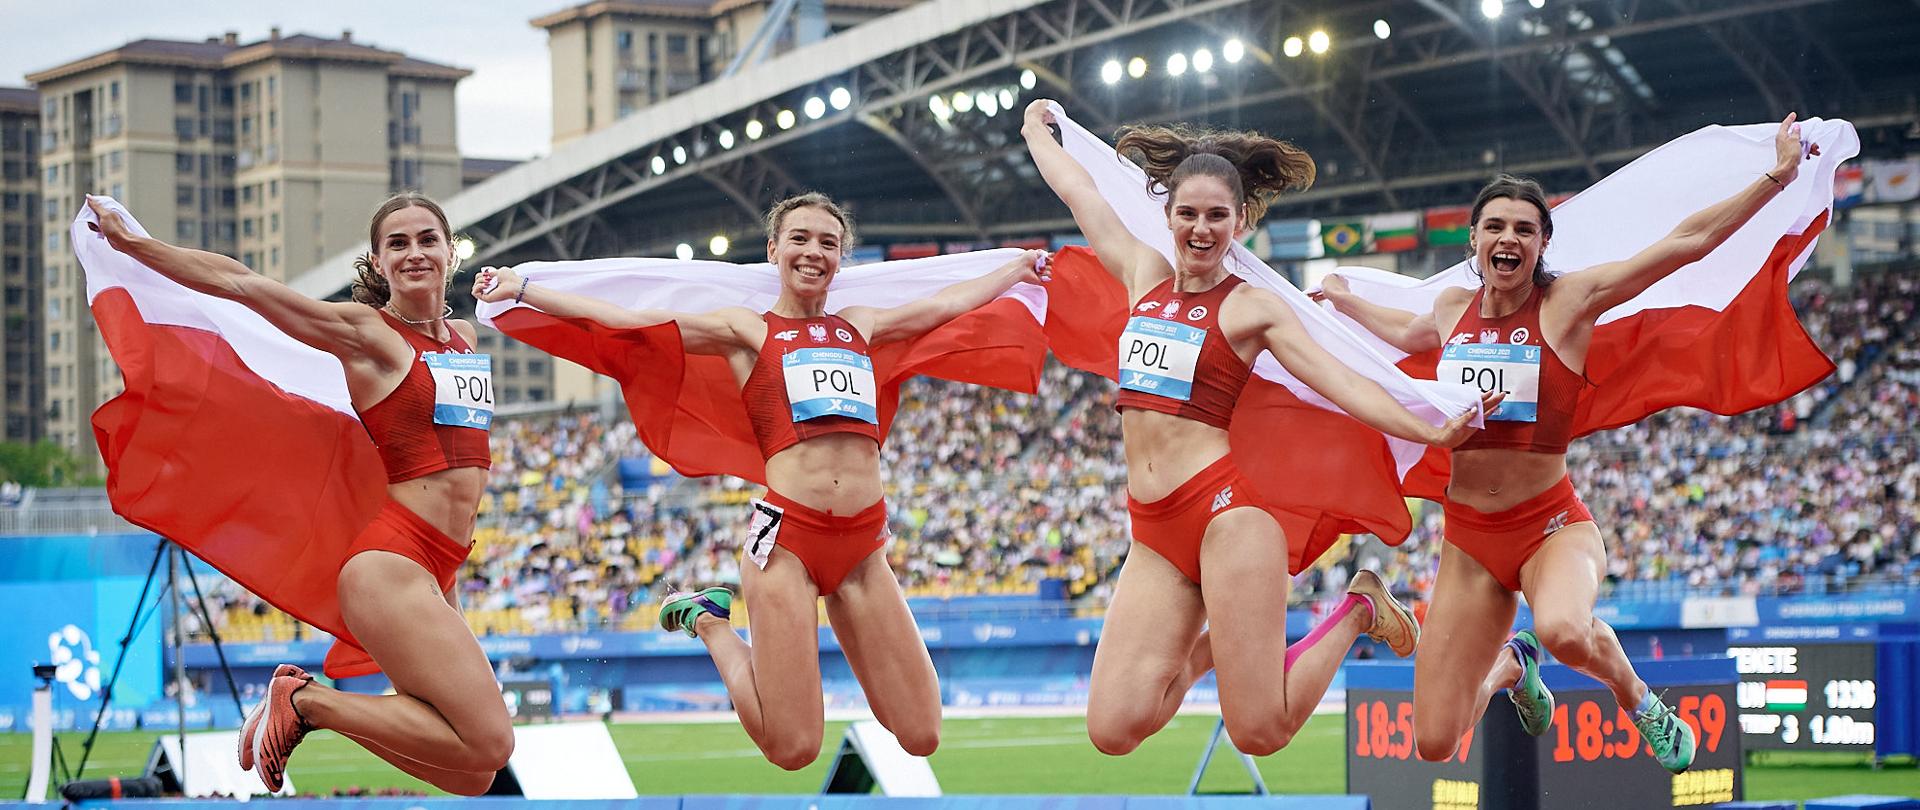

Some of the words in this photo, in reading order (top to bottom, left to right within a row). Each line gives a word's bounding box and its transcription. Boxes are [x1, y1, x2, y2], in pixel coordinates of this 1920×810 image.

[1127, 339, 1169, 370] POL
[454, 375, 492, 404] POL
[812, 369, 861, 396] POL
[1461, 367, 1511, 395] POL
[751, 503, 783, 555] 7
[1782, 714, 1799, 744] 3
